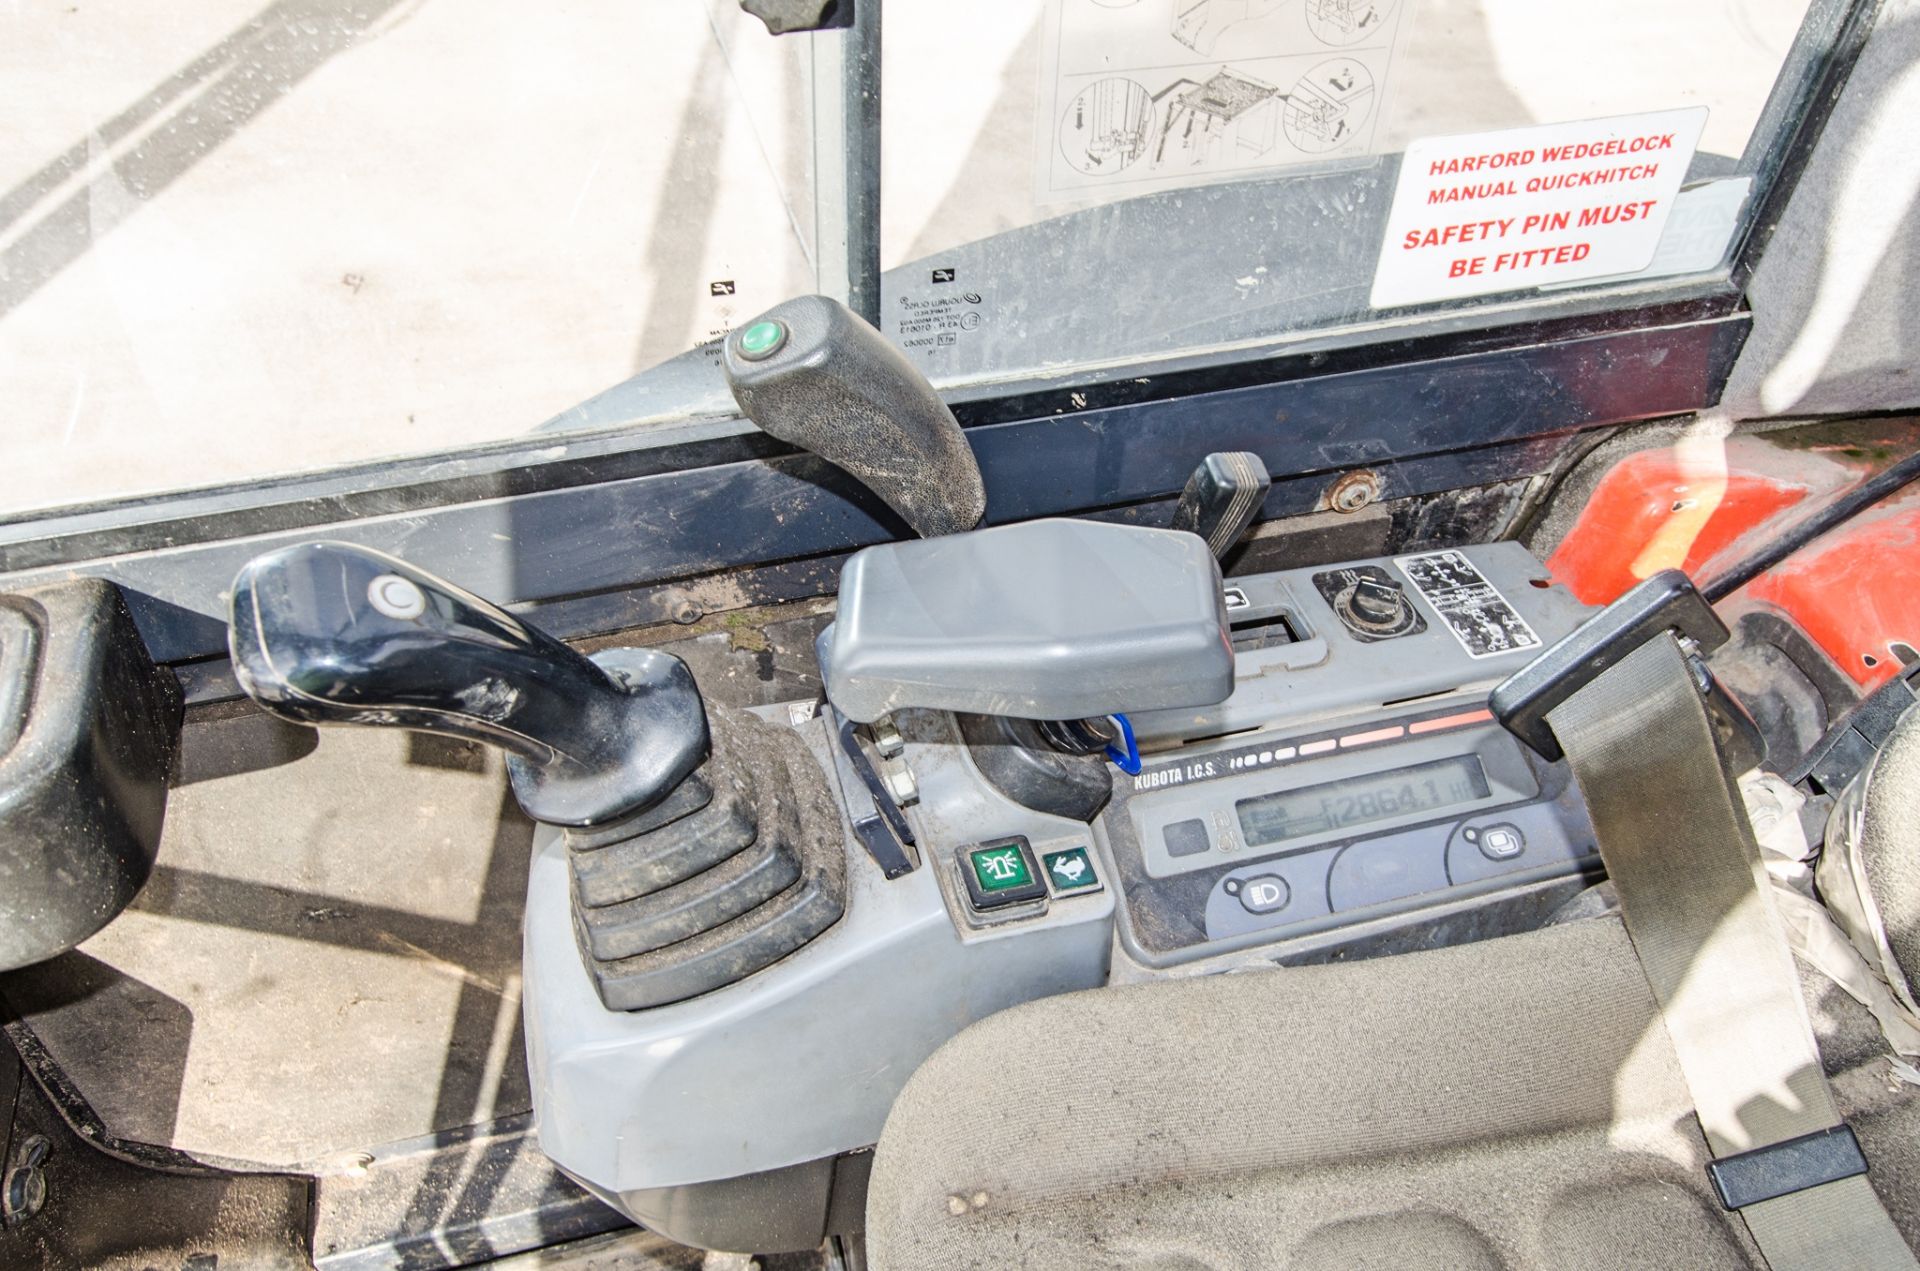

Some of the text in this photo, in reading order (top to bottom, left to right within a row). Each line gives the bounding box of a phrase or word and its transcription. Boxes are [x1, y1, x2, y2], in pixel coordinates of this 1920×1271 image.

[1429, 133, 1676, 176] HARFORD WEDGELOCK
[1427, 163, 1659, 205] MANUAL QUICKHITCH
[1403, 200, 1657, 250] SAFETY PIN MUST
[1448, 243, 1591, 279] BE FITTED
[1134, 767, 1183, 790] KUBOTA
